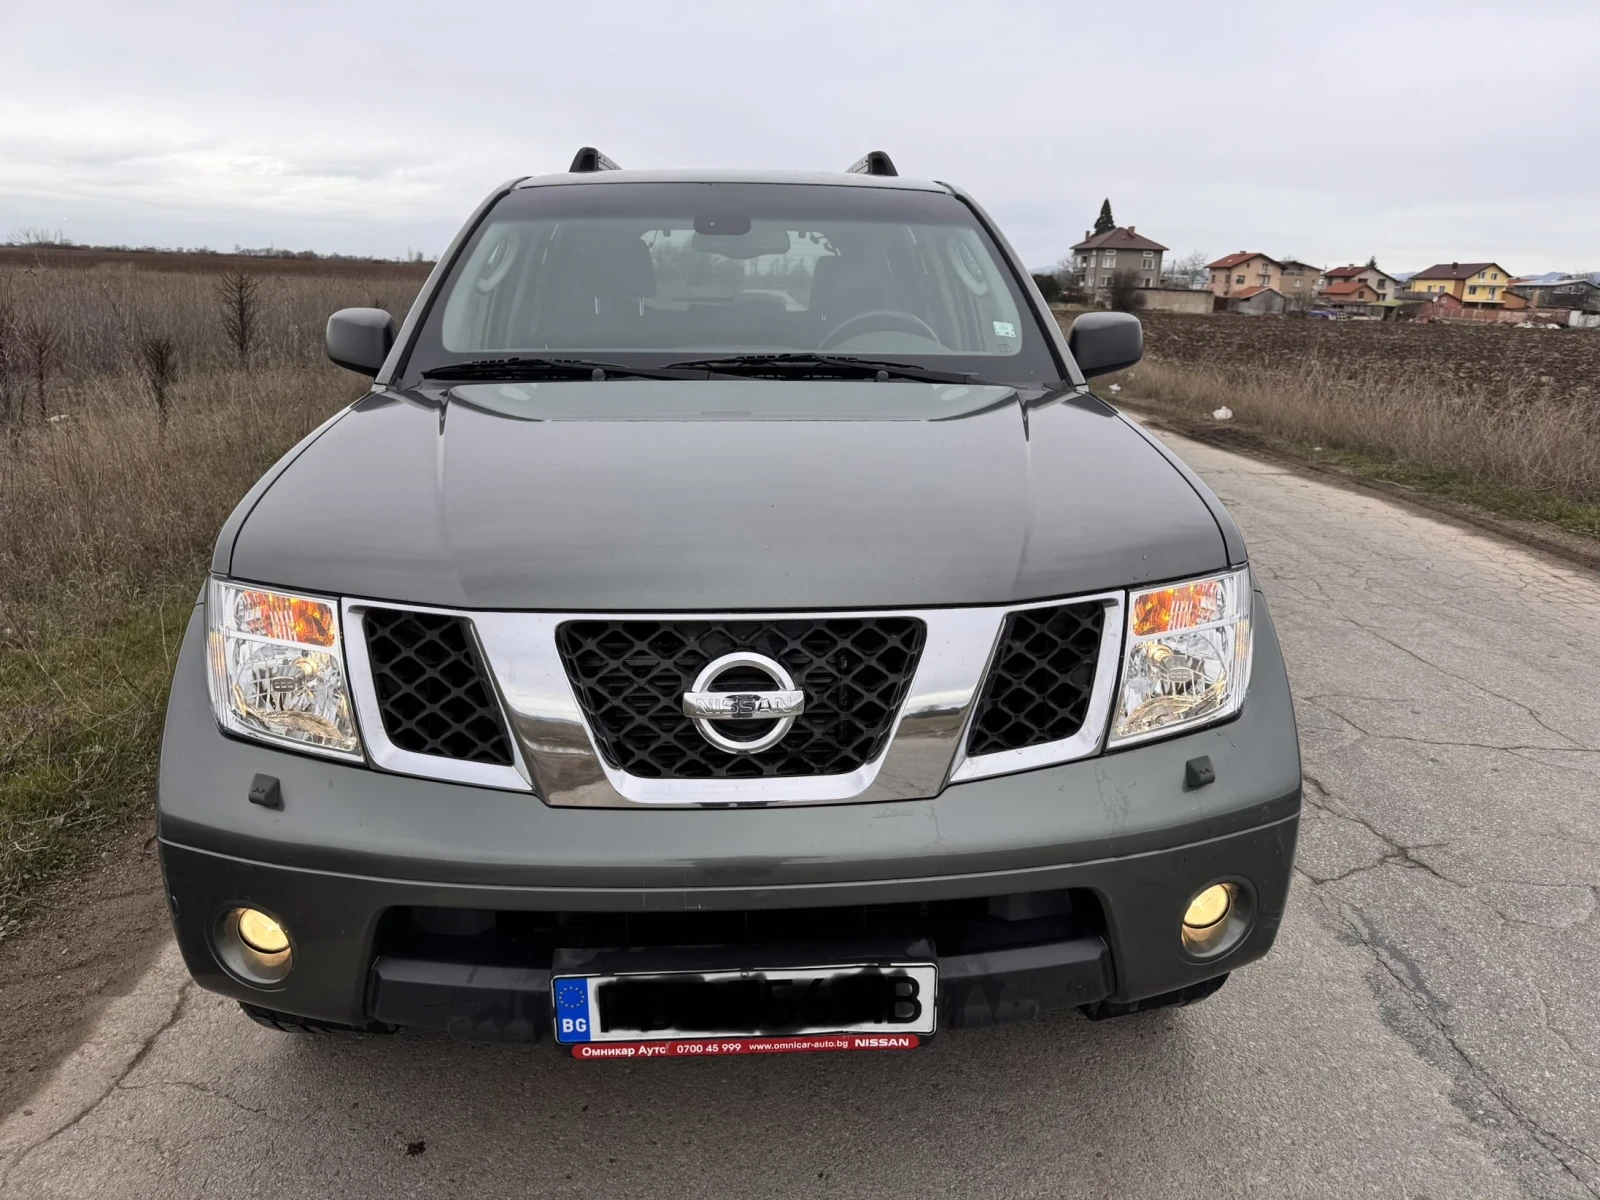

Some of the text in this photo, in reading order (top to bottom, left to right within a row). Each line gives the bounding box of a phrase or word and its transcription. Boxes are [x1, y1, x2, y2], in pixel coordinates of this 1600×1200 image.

[695, 696, 792, 716] NISSAN
[562, 1018, 587, 1033] BG
[582, 1046, 635, 1057] Омникар
[676, 1044, 703, 1054] 0700
[705, 1044, 719, 1053] 45
[721, 1043, 742, 1052] 999
[749, 1039, 848, 1050] www.omnicar-auto.bg
[854, 1038, 910, 1047] NISSAN
